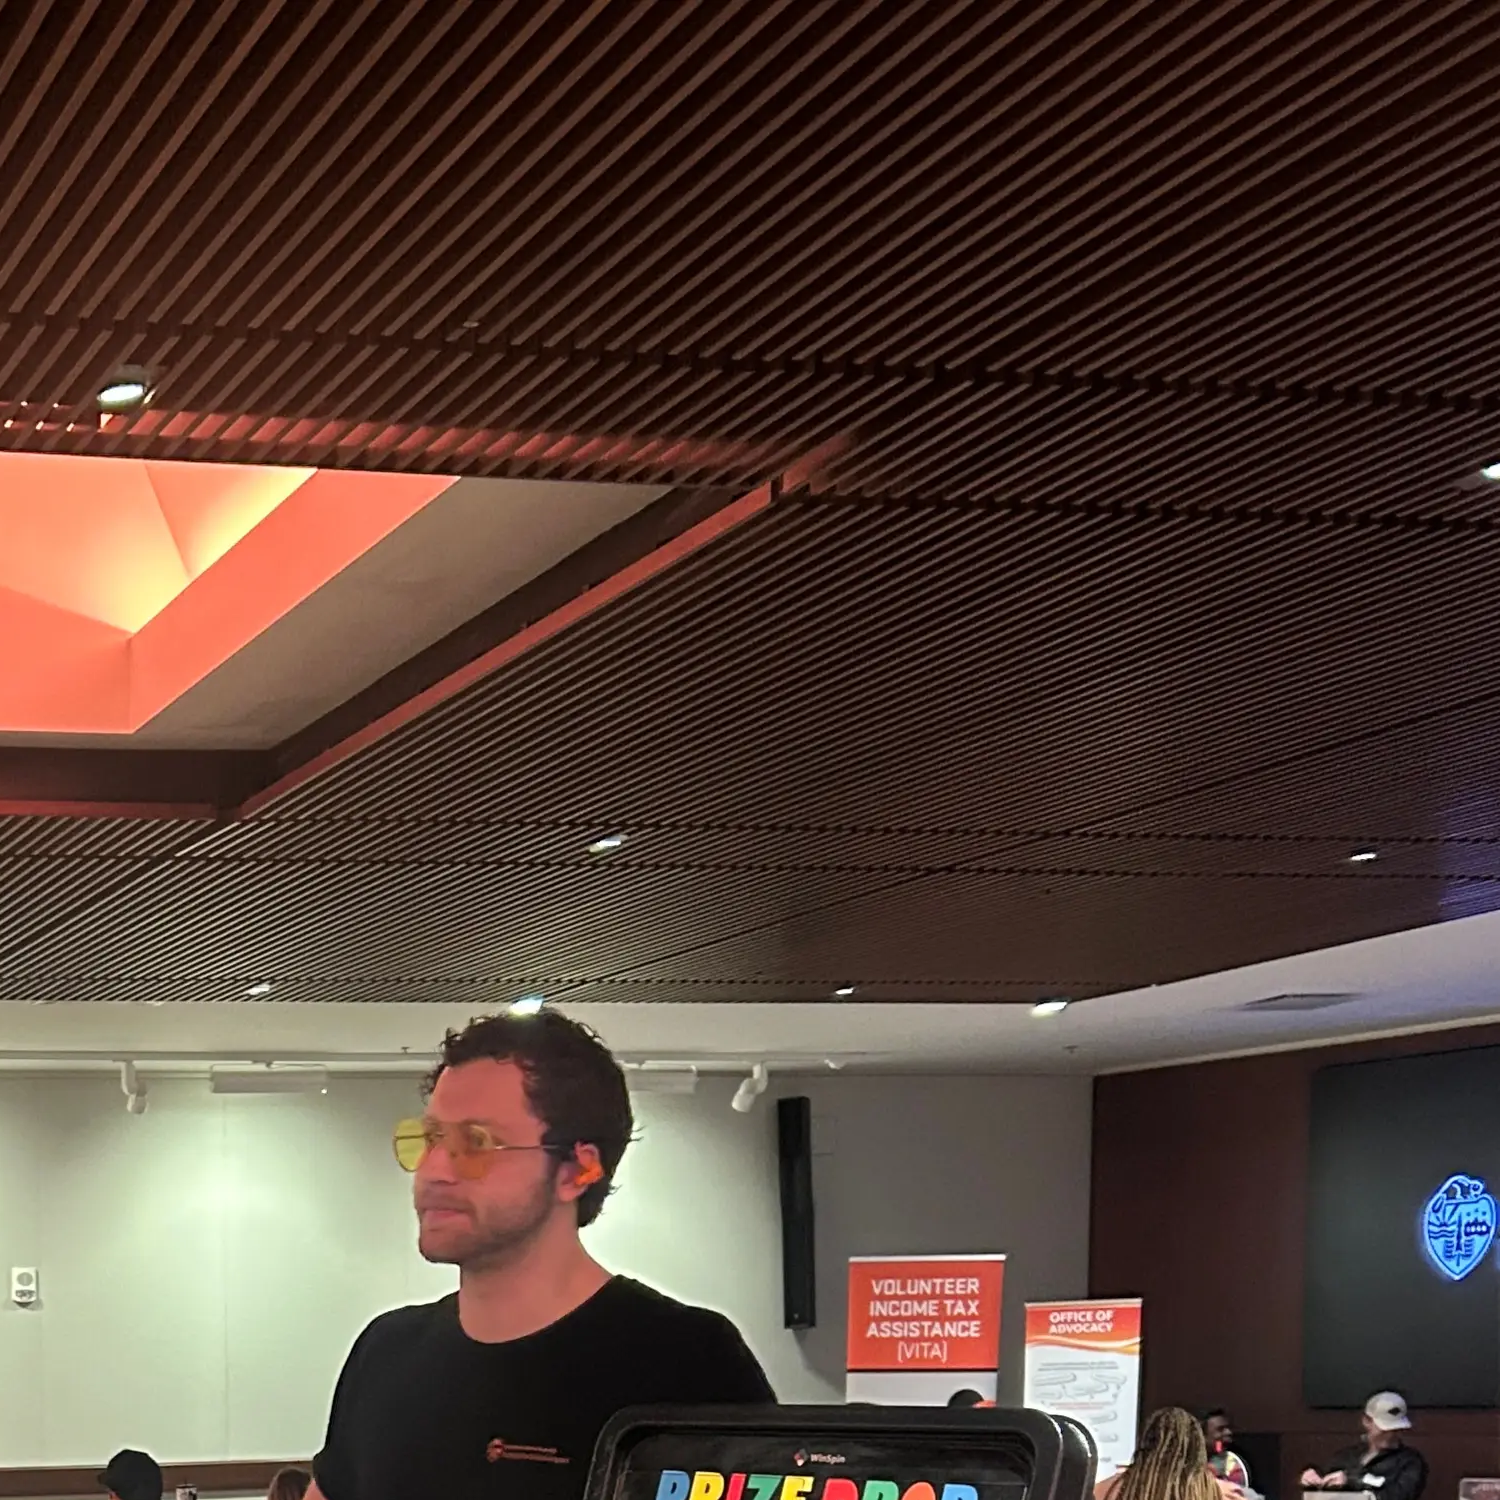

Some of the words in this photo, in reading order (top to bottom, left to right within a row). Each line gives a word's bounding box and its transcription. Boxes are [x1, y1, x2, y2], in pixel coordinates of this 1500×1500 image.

[871, 1278, 980, 1296] VOLUNTEER
[869, 1299, 939, 1317] INCOME
[943, 1299, 980, 1316] TAX
[1049, 1311, 1093, 1323] OFFICE
[1095, 1309, 1114, 1321] OF
[866, 1320, 981, 1338] ASSISTANCE
[1049, 1322, 1113, 1334] ADVOCACY
